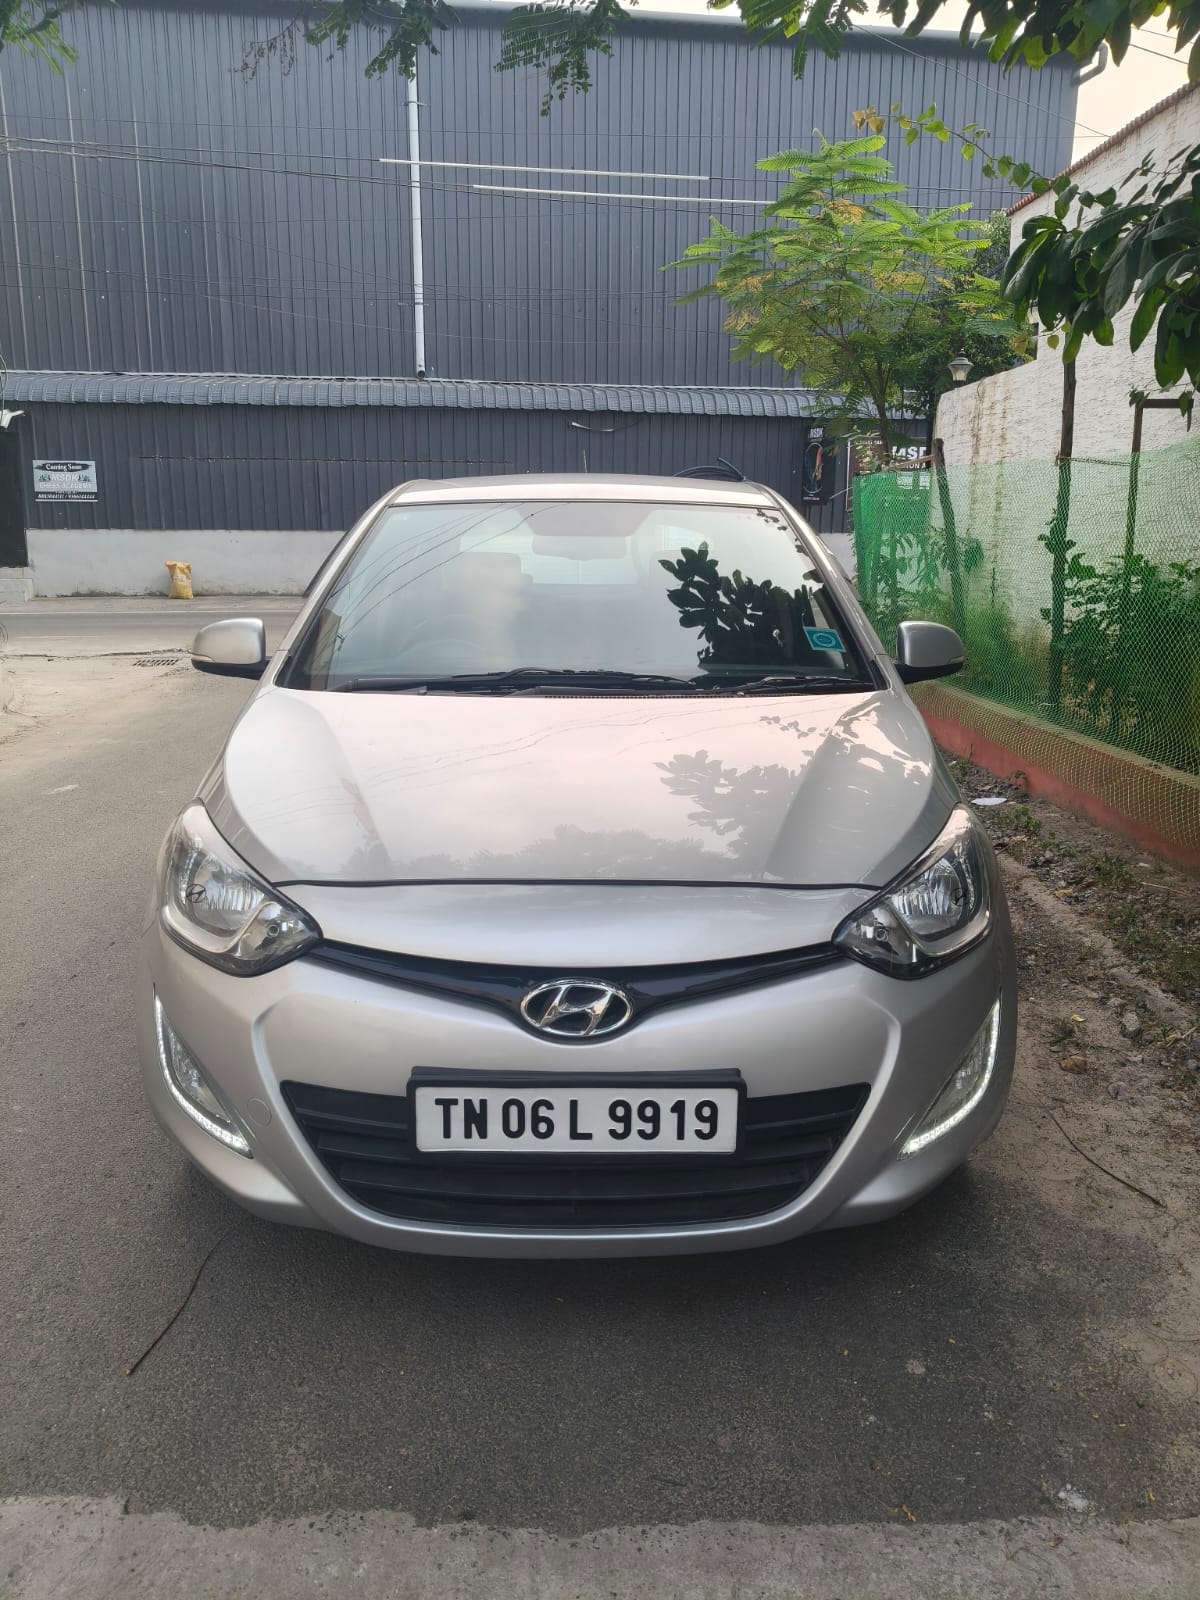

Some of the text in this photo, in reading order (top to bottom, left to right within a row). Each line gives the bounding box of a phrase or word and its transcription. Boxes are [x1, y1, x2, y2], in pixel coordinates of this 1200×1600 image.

[45, 463, 67, 472] Coming
[434, 1097, 719, 1141] TN 06 L 9919
